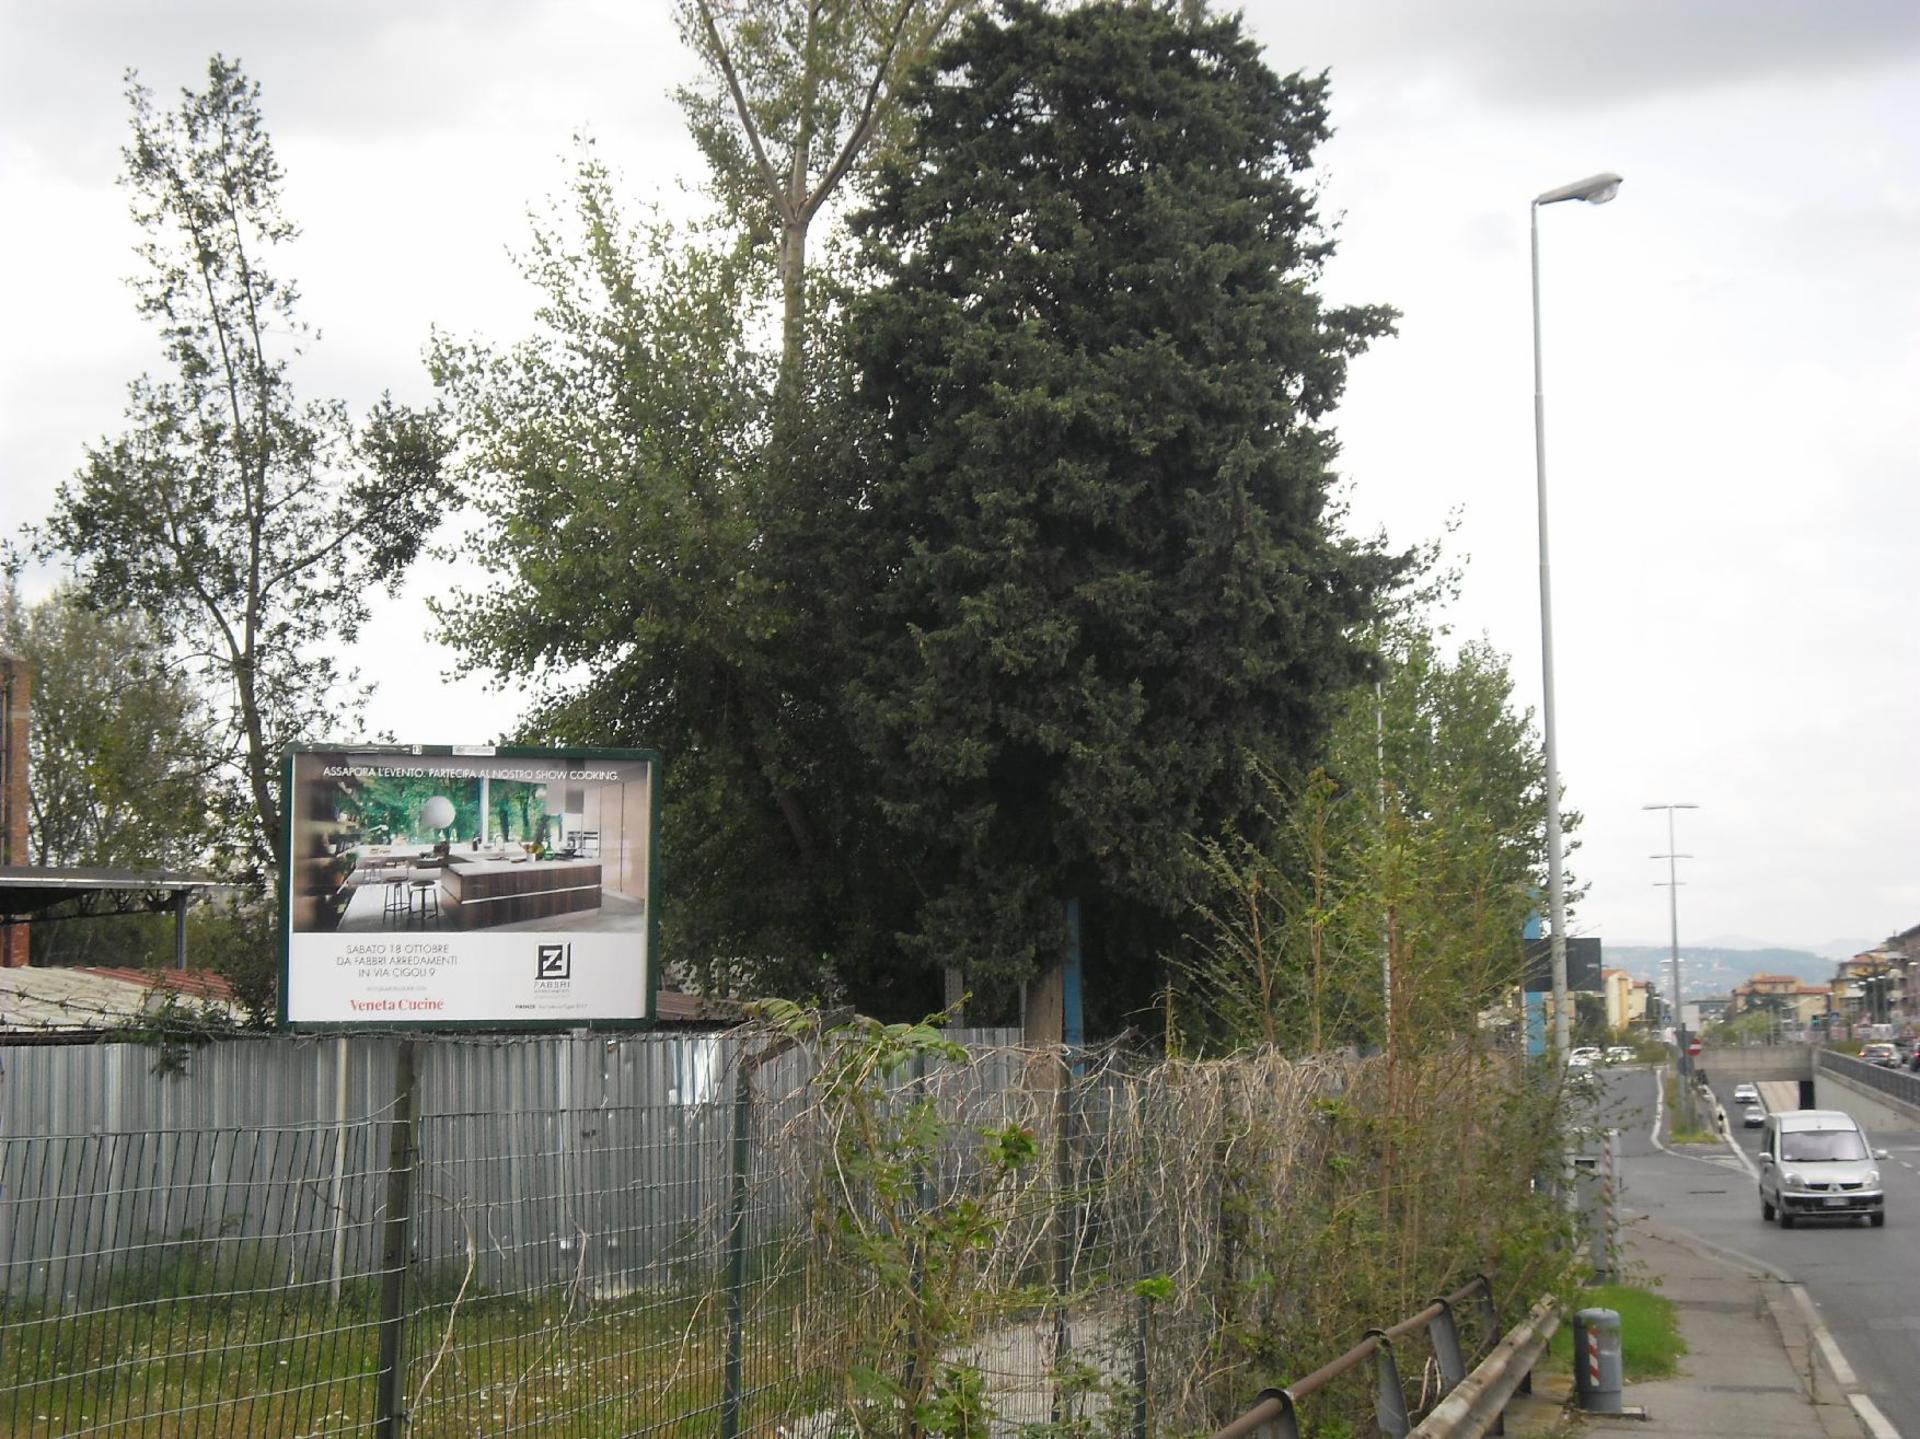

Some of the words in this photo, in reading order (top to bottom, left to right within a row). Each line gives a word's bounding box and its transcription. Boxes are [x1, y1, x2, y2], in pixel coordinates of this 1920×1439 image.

[323, 767, 376, 777] ASSAPORA
[428, 768, 476, 778] PARTECIPA
[492, 769, 533, 779] NOSTRO
[535, 770, 568, 780] SHOW
[346, 944, 386, 954] SABATO
[390, 944, 402, 954] 18
[404, 944, 449, 954] OTTOBRE
[336, 956, 350, 965] DA
[354, 956, 386, 965] FABBRI
[389, 955, 457, 965] ARREDAMENTI
[358, 968, 370, 977] IN
[374, 968, 390, 977] VIA
[392, 968, 427, 977] CIGOLI
[429, 968, 436, 977] 9
[350, 999, 395, 1011] Veneta
[398, 997, 444, 1011] Cucine
